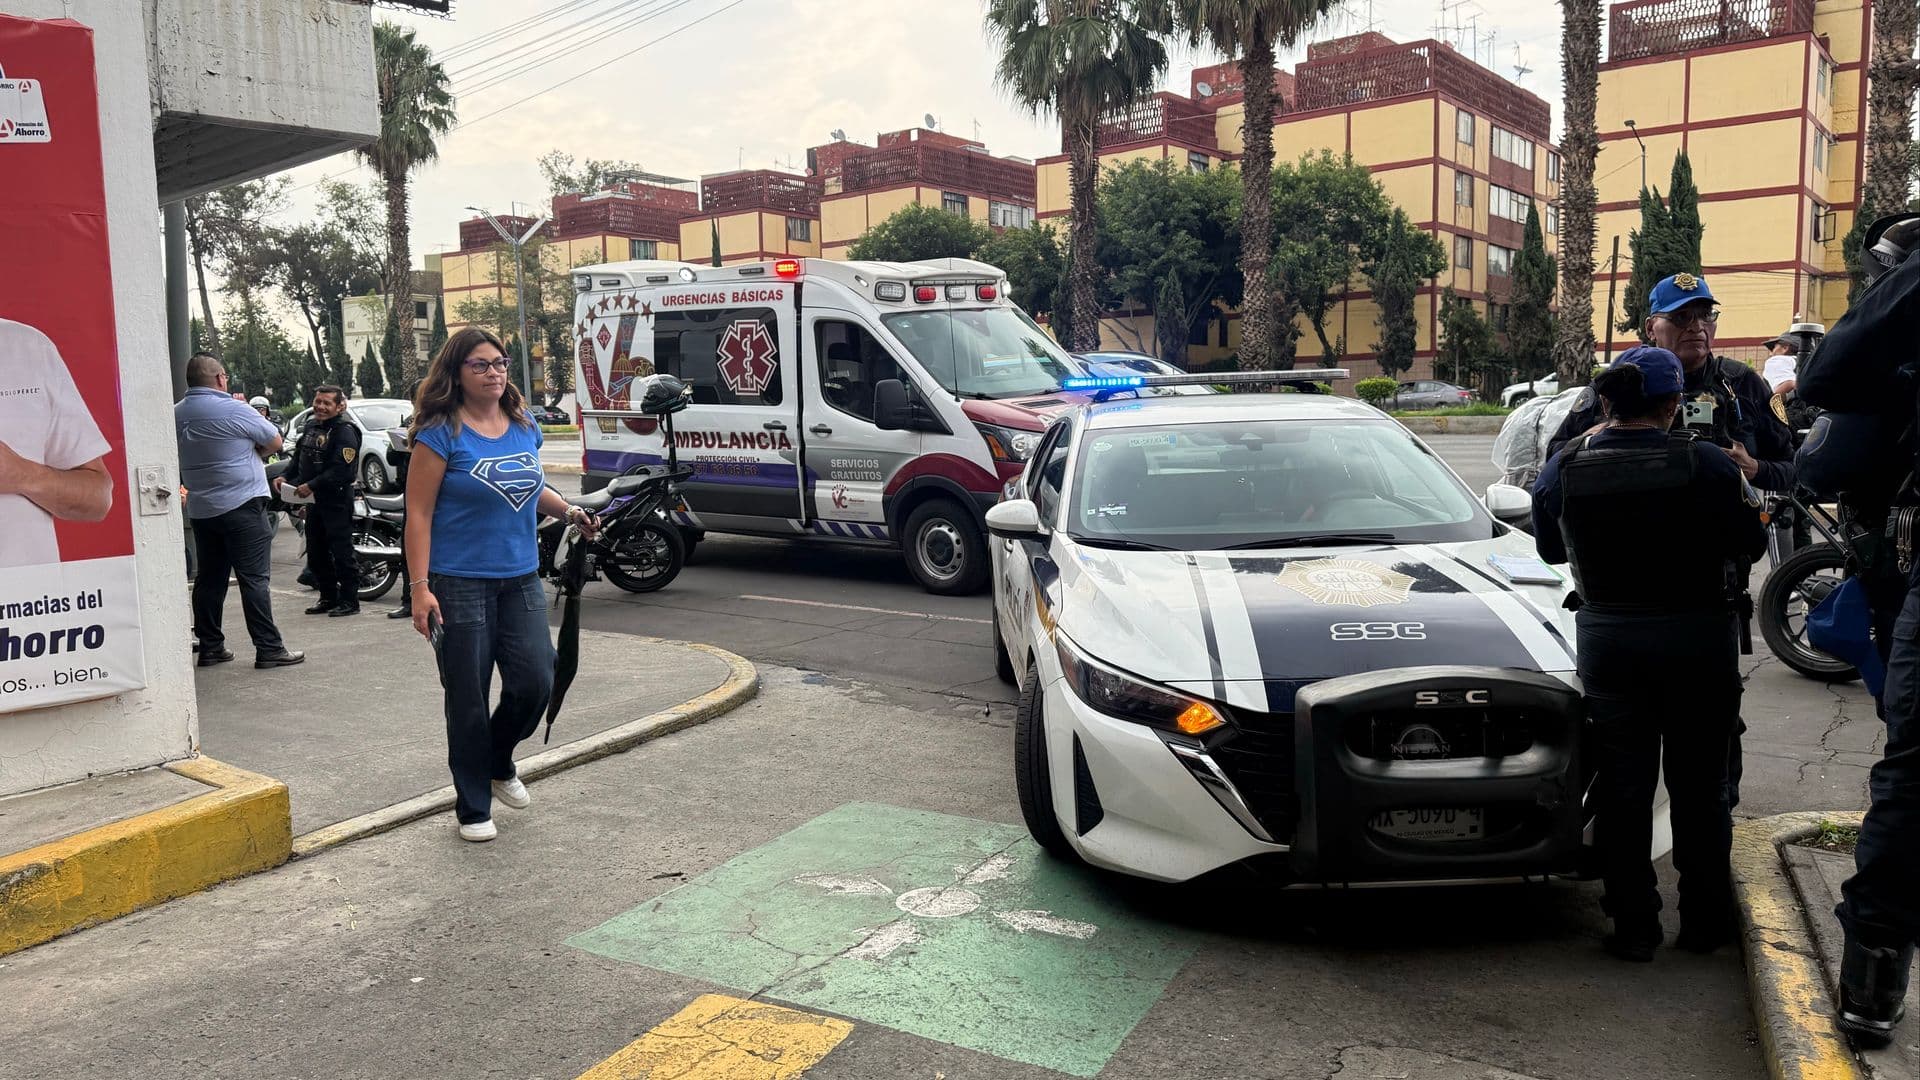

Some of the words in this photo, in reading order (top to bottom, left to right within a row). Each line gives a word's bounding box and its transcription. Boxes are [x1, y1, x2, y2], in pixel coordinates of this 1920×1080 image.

[15, 128, 45, 136] Ahorro
[662, 292, 726, 306] URGENCIAS
[732, 288, 784, 302] BÁSICAS
[739, 455, 757, 463] CIVIL
[831, 459, 879, 468] SERVICIOS
[831, 471, 882, 480] GRATUITOS
[77, 589, 103, 610] del
[1330, 622, 1427, 641] SSC
[0, 625, 105, 661] horro
[0, 678, 46, 694] os...
[1392, 743, 1451, 754] NISSAN
